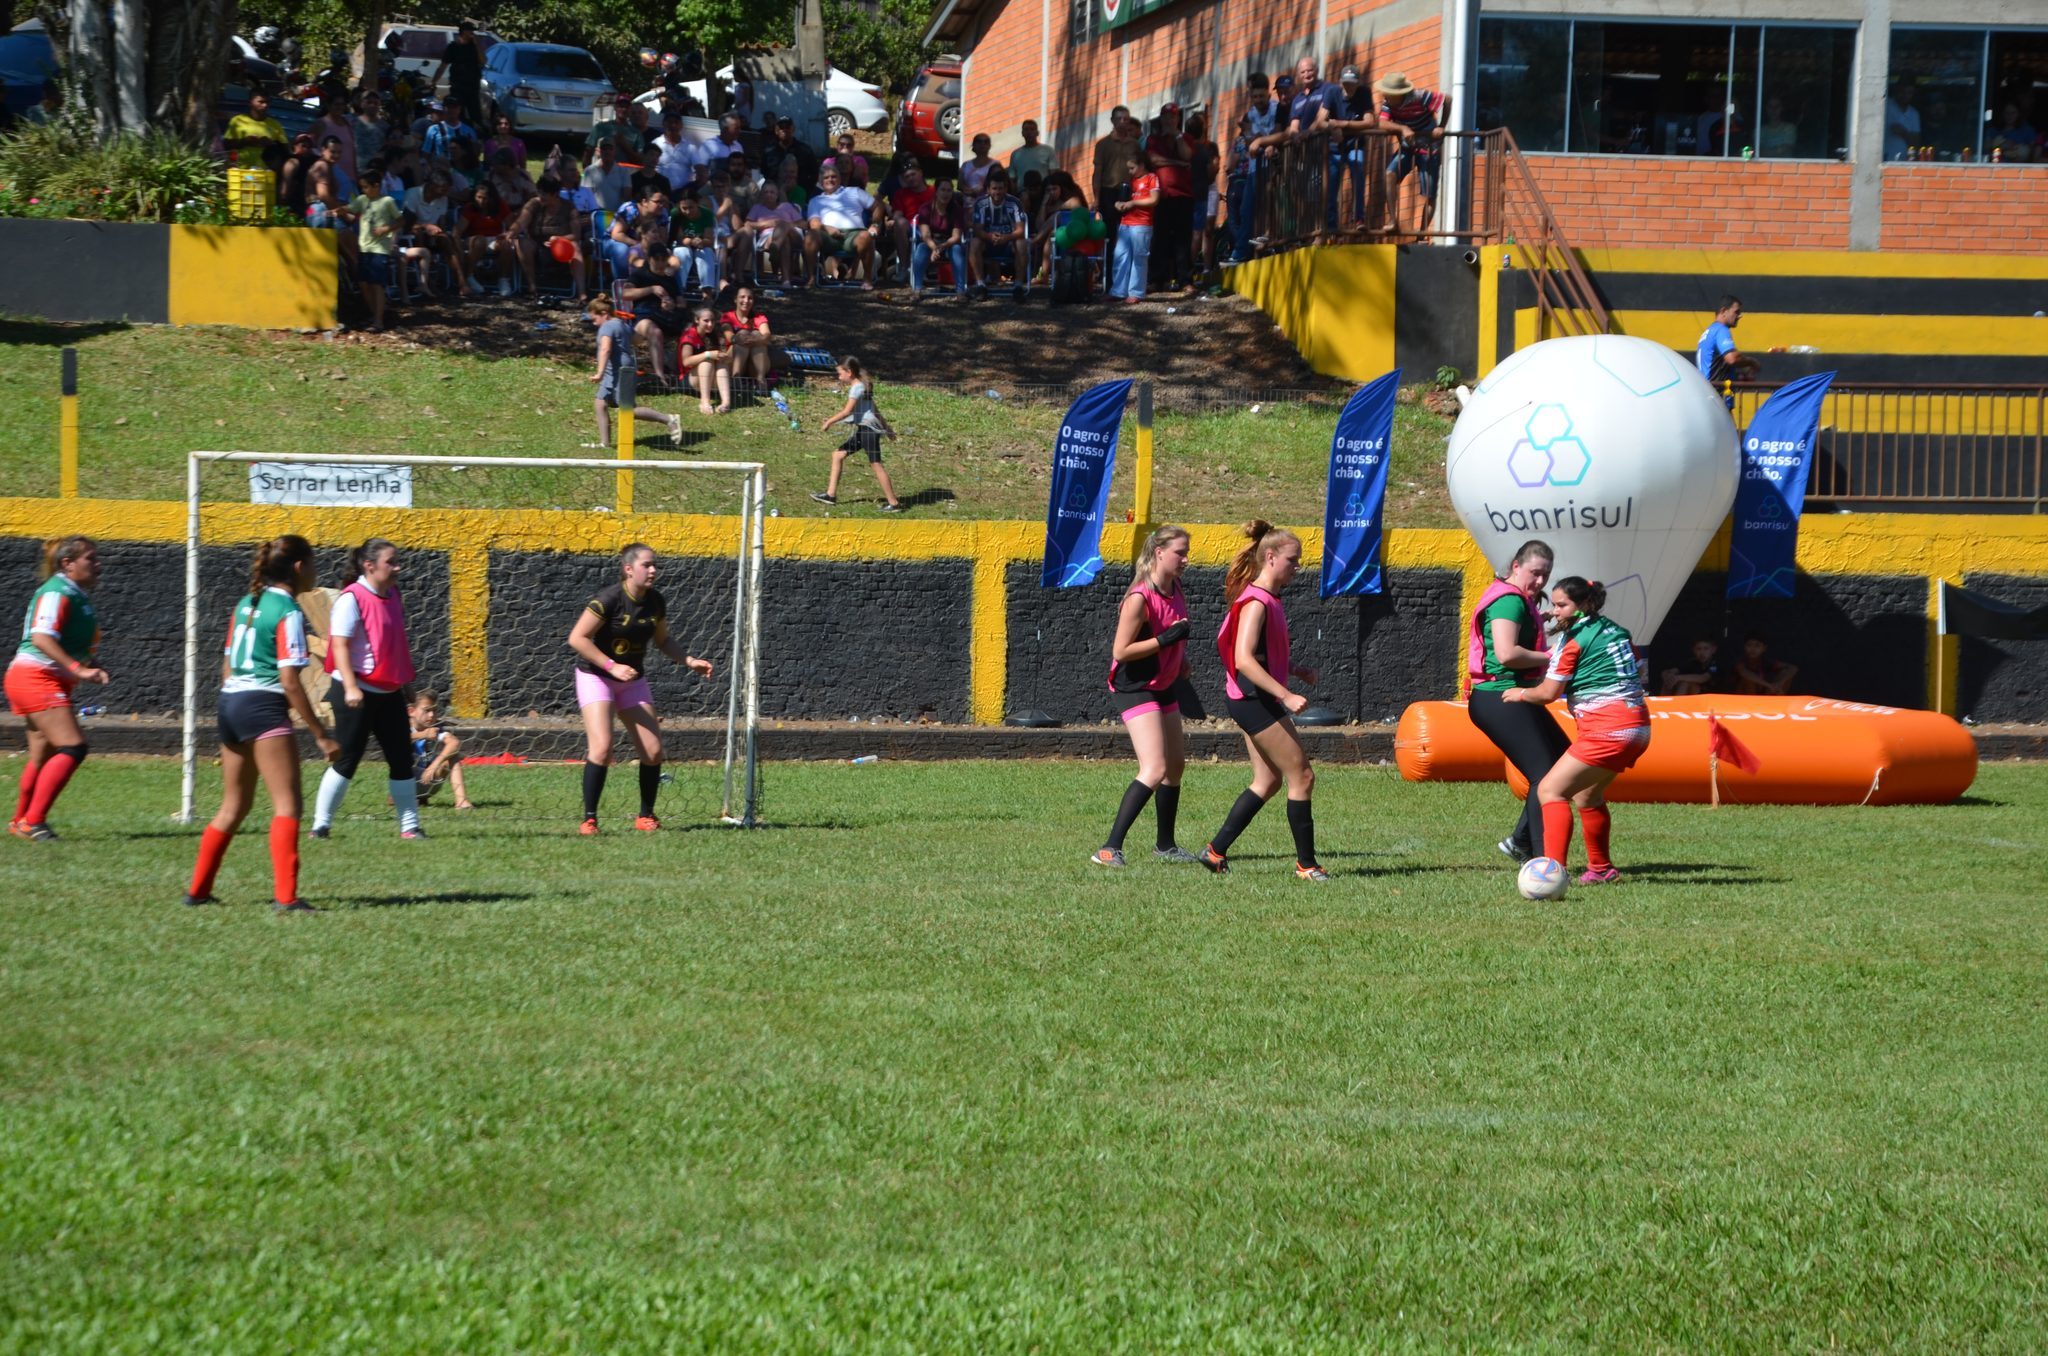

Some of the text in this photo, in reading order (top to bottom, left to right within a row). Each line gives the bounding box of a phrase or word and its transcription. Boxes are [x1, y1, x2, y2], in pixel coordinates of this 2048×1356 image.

[1062, 425, 1110, 443] O agro é
[1060, 443, 1105, 458] o nosso
[1336, 437, 1384, 452] O agro é
[1747, 437, 1806, 453] O agro é
[1060, 455, 1090, 470] chão.
[1335, 454, 1379, 465] o nosso
[1747, 455, 1802, 466] o nosso
[1335, 466, 1365, 479] chão.
[1746, 467, 1783, 480] chão.
[261, 472, 401, 494] Serrar Lenha
[1058, 506, 1096, 521] banrisul
[1484, 496, 1633, 534] banrisul
[1334, 517, 1374, 528] banrisu
[1744, 520, 1790, 530] banrisu
